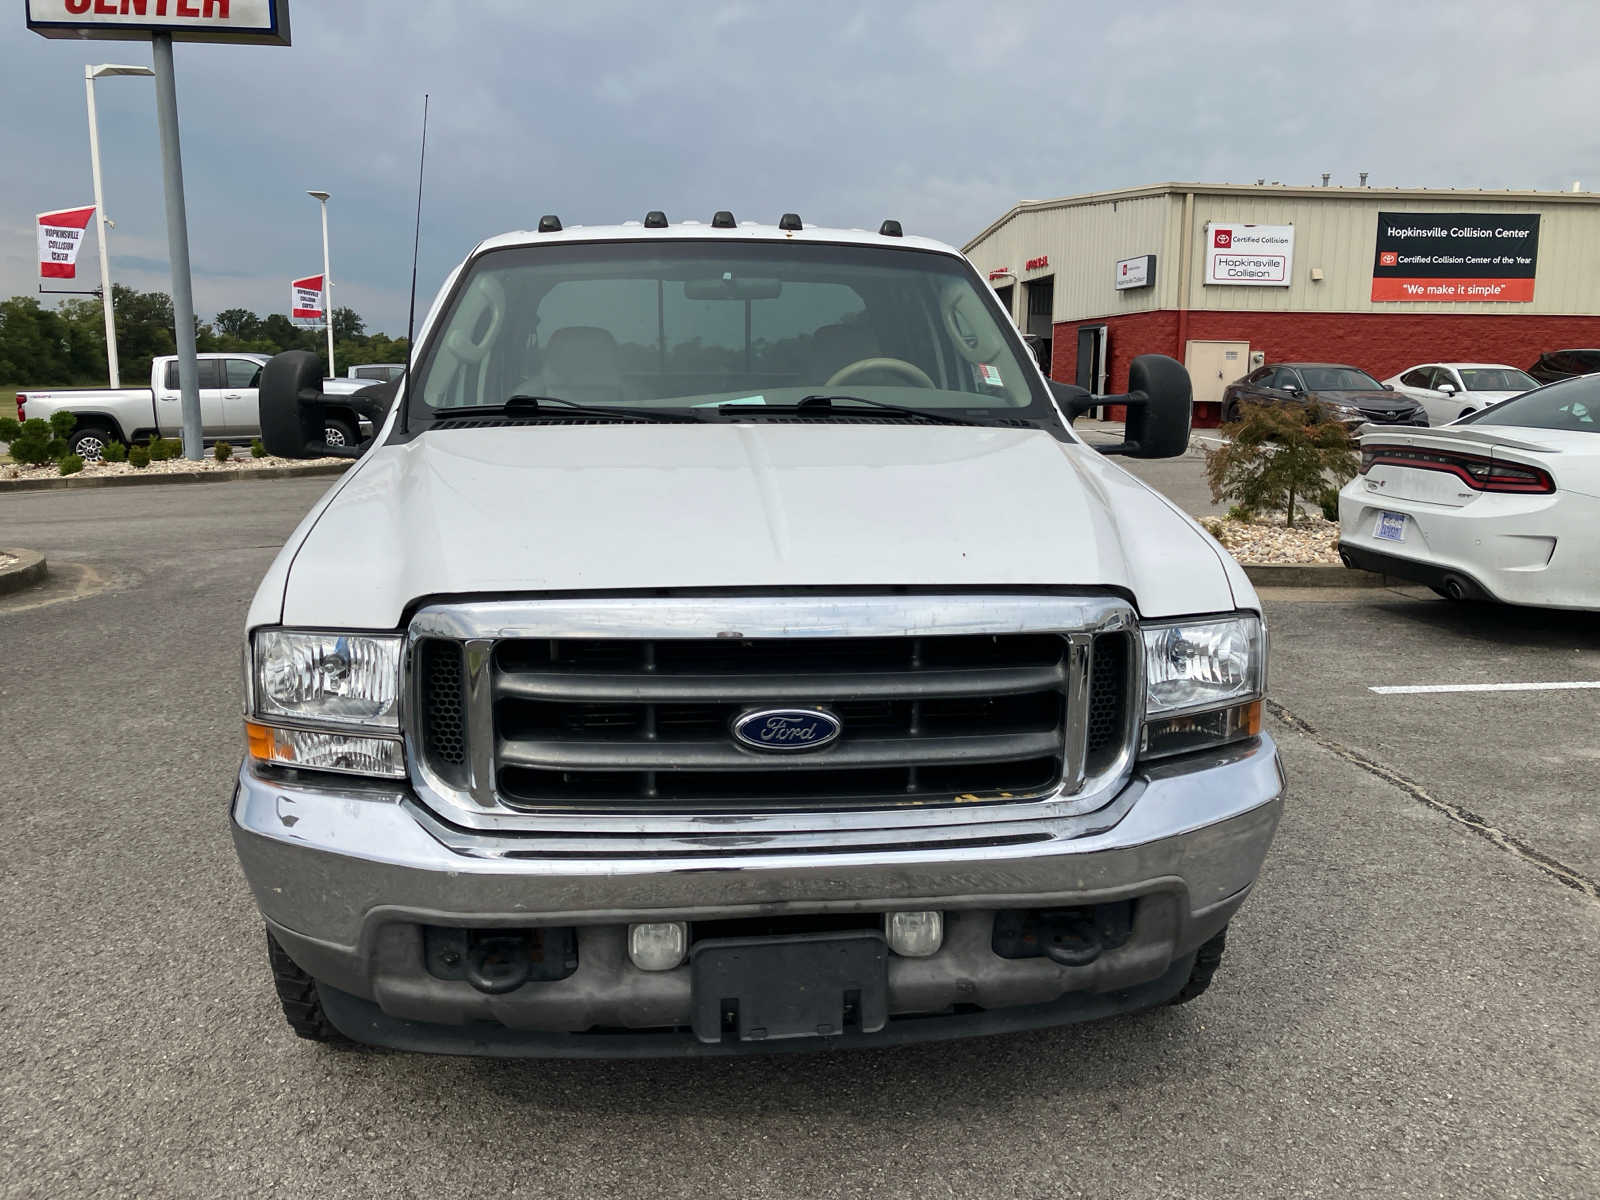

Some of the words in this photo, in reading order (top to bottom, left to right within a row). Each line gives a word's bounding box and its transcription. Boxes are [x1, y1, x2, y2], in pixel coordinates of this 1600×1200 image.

[1387, 227, 1448, 239] Hopkinsville
[1450, 227, 1493, 238] Collision
[1495, 228, 1530, 238] Center
[1261, 236, 1289, 244] Collision
[1218, 258, 1281, 268] Hopkinsville
[1398, 255, 1431, 264] Certified
[1432, 255, 1464, 264] Collision
[1465, 255, 1491, 264] Center
[1492, 256, 1501, 264] of
[1502, 256, 1514, 264] the
[1515, 256, 1532, 264] Year
[1227, 268, 1270, 278] Collision
[1427, 284, 1455, 295] make
[1457, 284, 1465, 295] it
[761, 717, 817, 740] Ford
